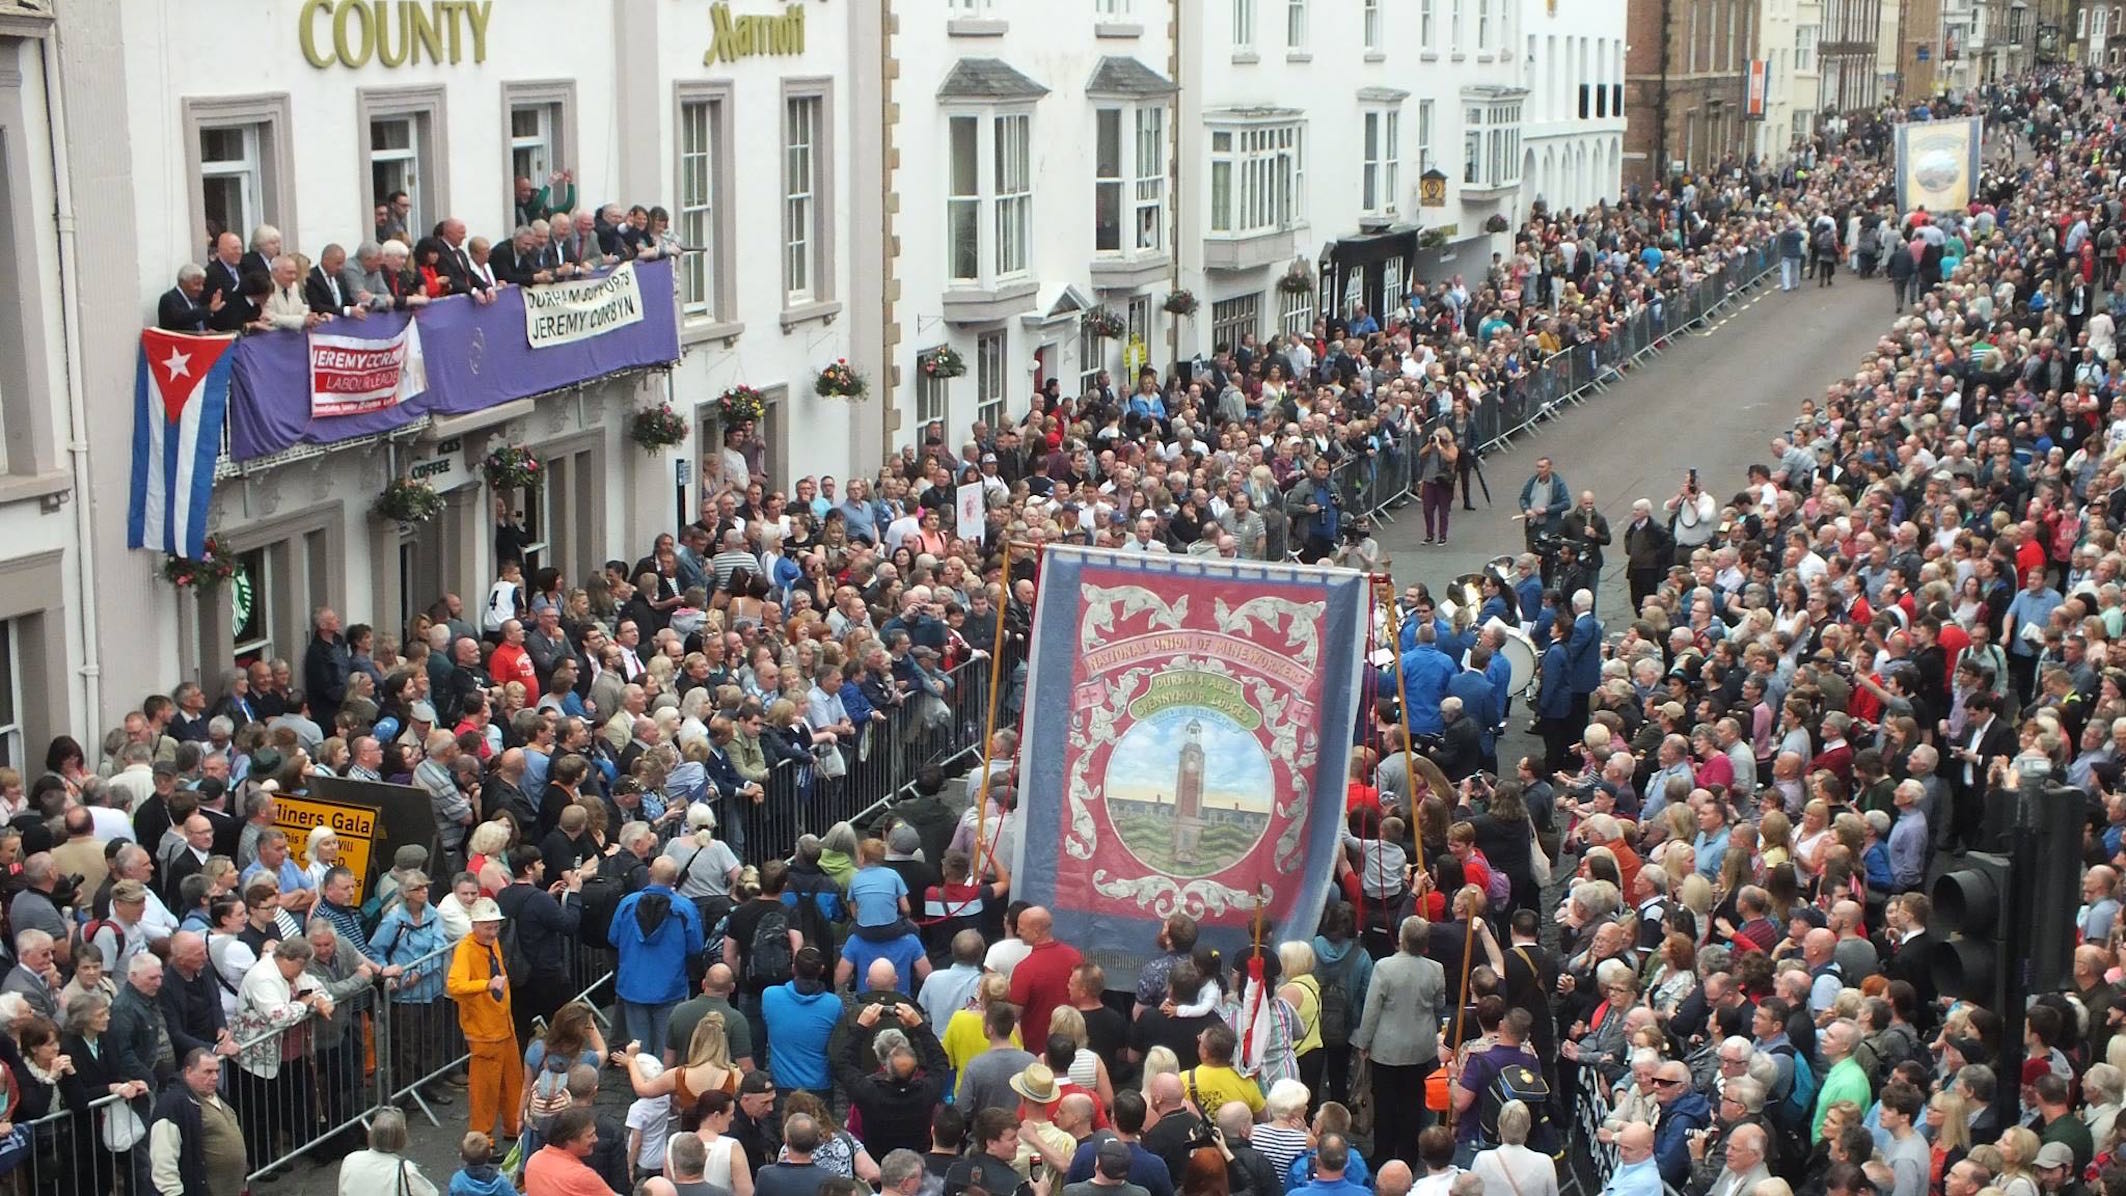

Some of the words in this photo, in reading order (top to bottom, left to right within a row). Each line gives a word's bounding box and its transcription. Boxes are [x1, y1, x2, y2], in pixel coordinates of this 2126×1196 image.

[299, 0, 490, 69] COUNTY
[703, 2, 805, 66] Marriott
[527, 289, 580, 309] DURHAM
[532, 311, 587, 340] JEREMY
[590, 294, 635, 328] CORBYN
[412, 459, 450, 479] COFFEE
[489, 590, 499, 611] 4
[1089, 641, 1149, 672] NATIONAL
[1154, 637, 1192, 652] UNION
[1197, 639, 1211, 651] OF
[1208, 679, 1238, 696] AREA
[277, 803, 324, 827] iners
[331, 812, 370, 834] Gala
